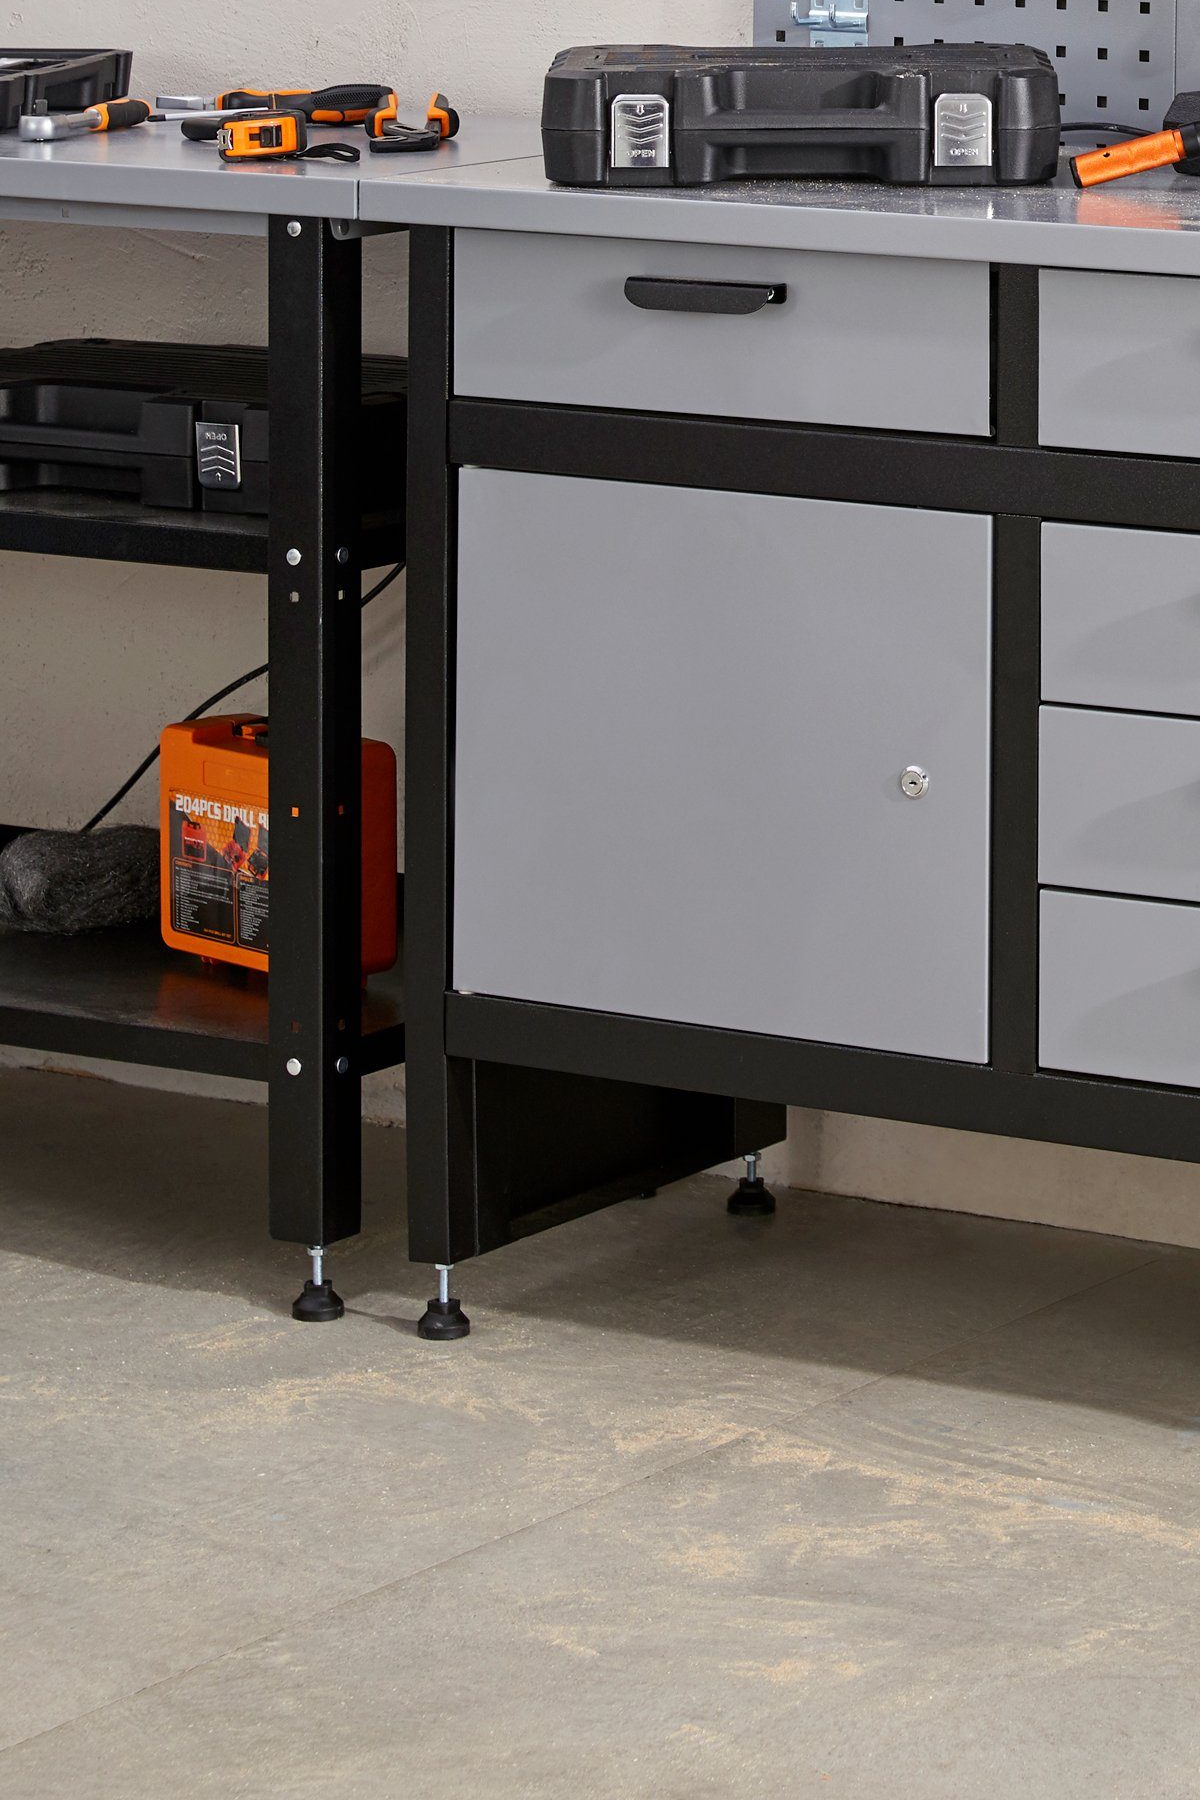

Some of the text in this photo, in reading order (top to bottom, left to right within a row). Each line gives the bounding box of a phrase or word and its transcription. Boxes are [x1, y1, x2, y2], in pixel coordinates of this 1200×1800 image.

[626, 149, 656, 158] OPEN
[949, 148, 979, 156] OPEN
[205, 431, 227, 441] OPEN
[175, 793, 222, 820] 204PCS
[223, 804, 257, 828] DRILL
